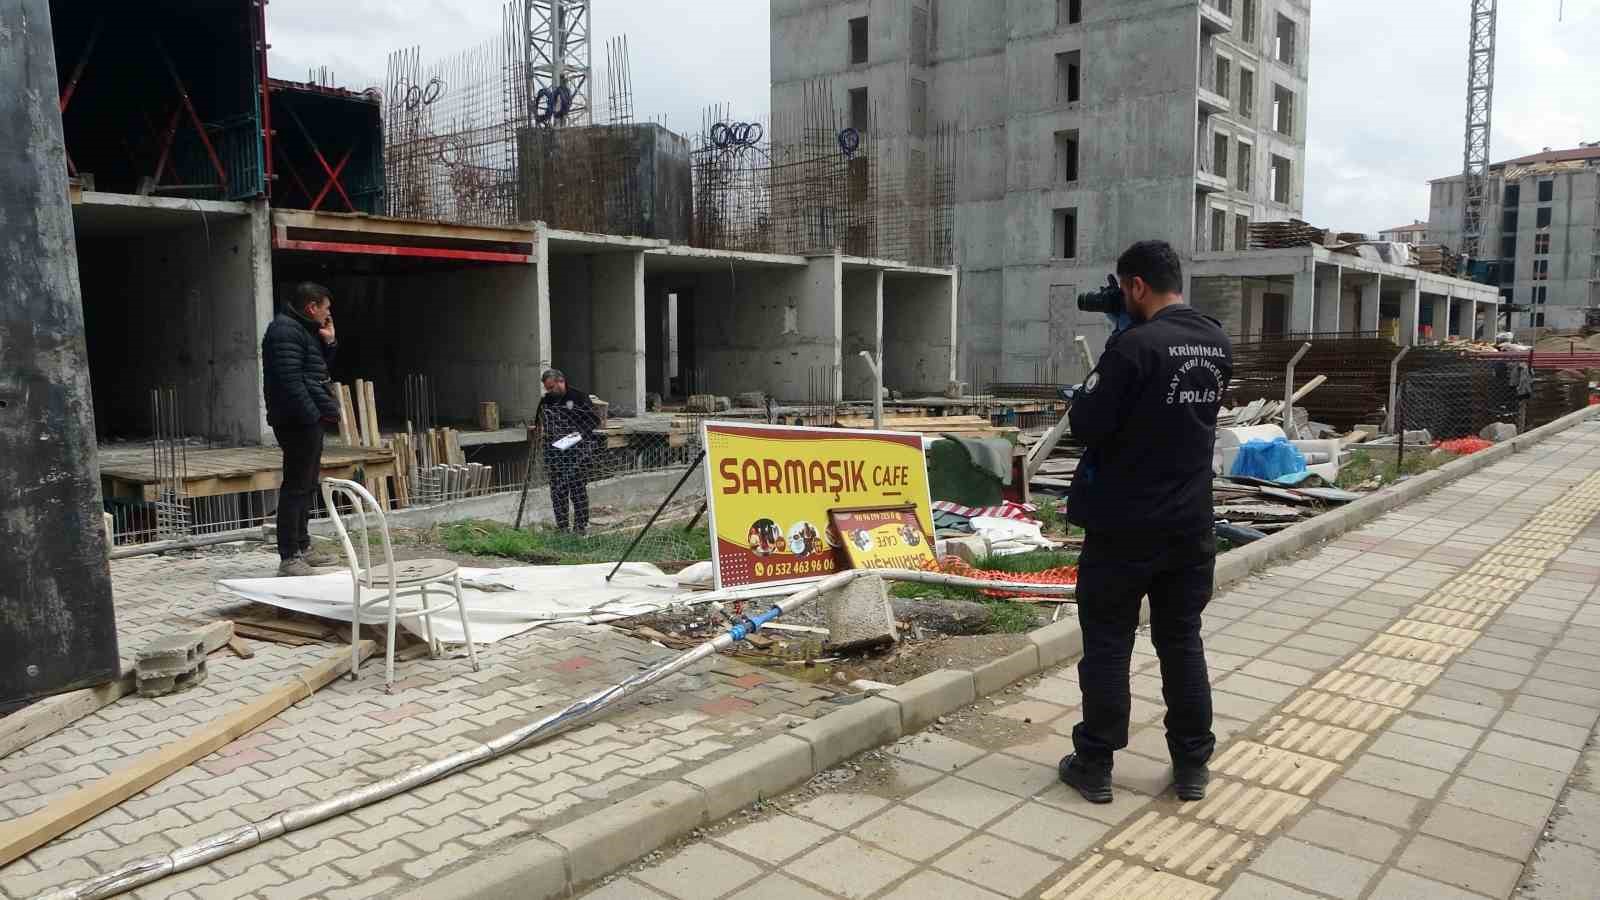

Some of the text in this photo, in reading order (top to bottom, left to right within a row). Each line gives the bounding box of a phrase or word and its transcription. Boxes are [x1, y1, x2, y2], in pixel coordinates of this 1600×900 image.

[1168, 344, 1226, 357] KRİMİNAL
[1166, 357, 1225, 404] OLAY YERİ İNCELE
[1179, 388, 1216, 403] POLİS
[719, 457, 909, 502] SARMAŞIK CAFE
[877, 535, 898, 547] CAFE
[767, 559, 834, 577] 0 532 463 96 06
